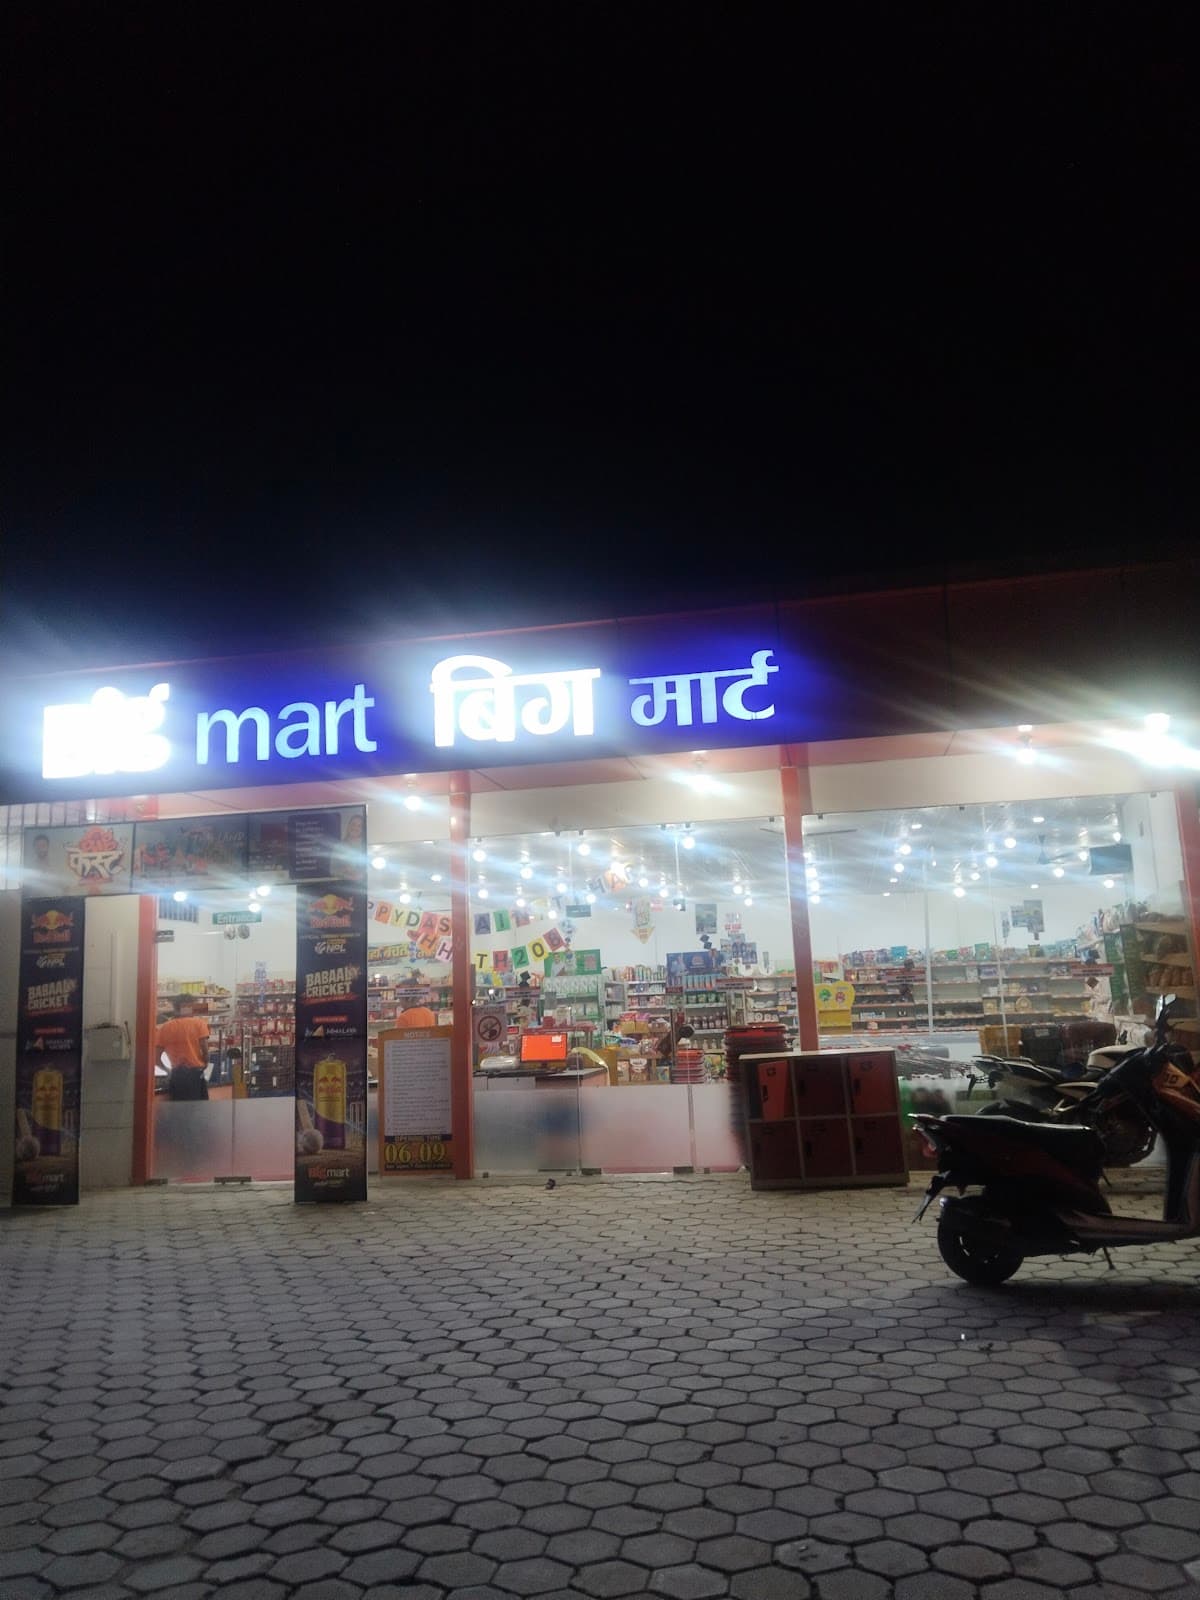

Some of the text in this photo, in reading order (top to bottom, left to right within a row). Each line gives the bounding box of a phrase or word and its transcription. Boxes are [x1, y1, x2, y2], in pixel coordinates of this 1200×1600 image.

[429, 650, 779, 747] बिग मार्ट
[196, 684, 377, 765] mart
[306, 967, 351, 988] BABAAL
[306, 981, 352, 998] CRICKET
